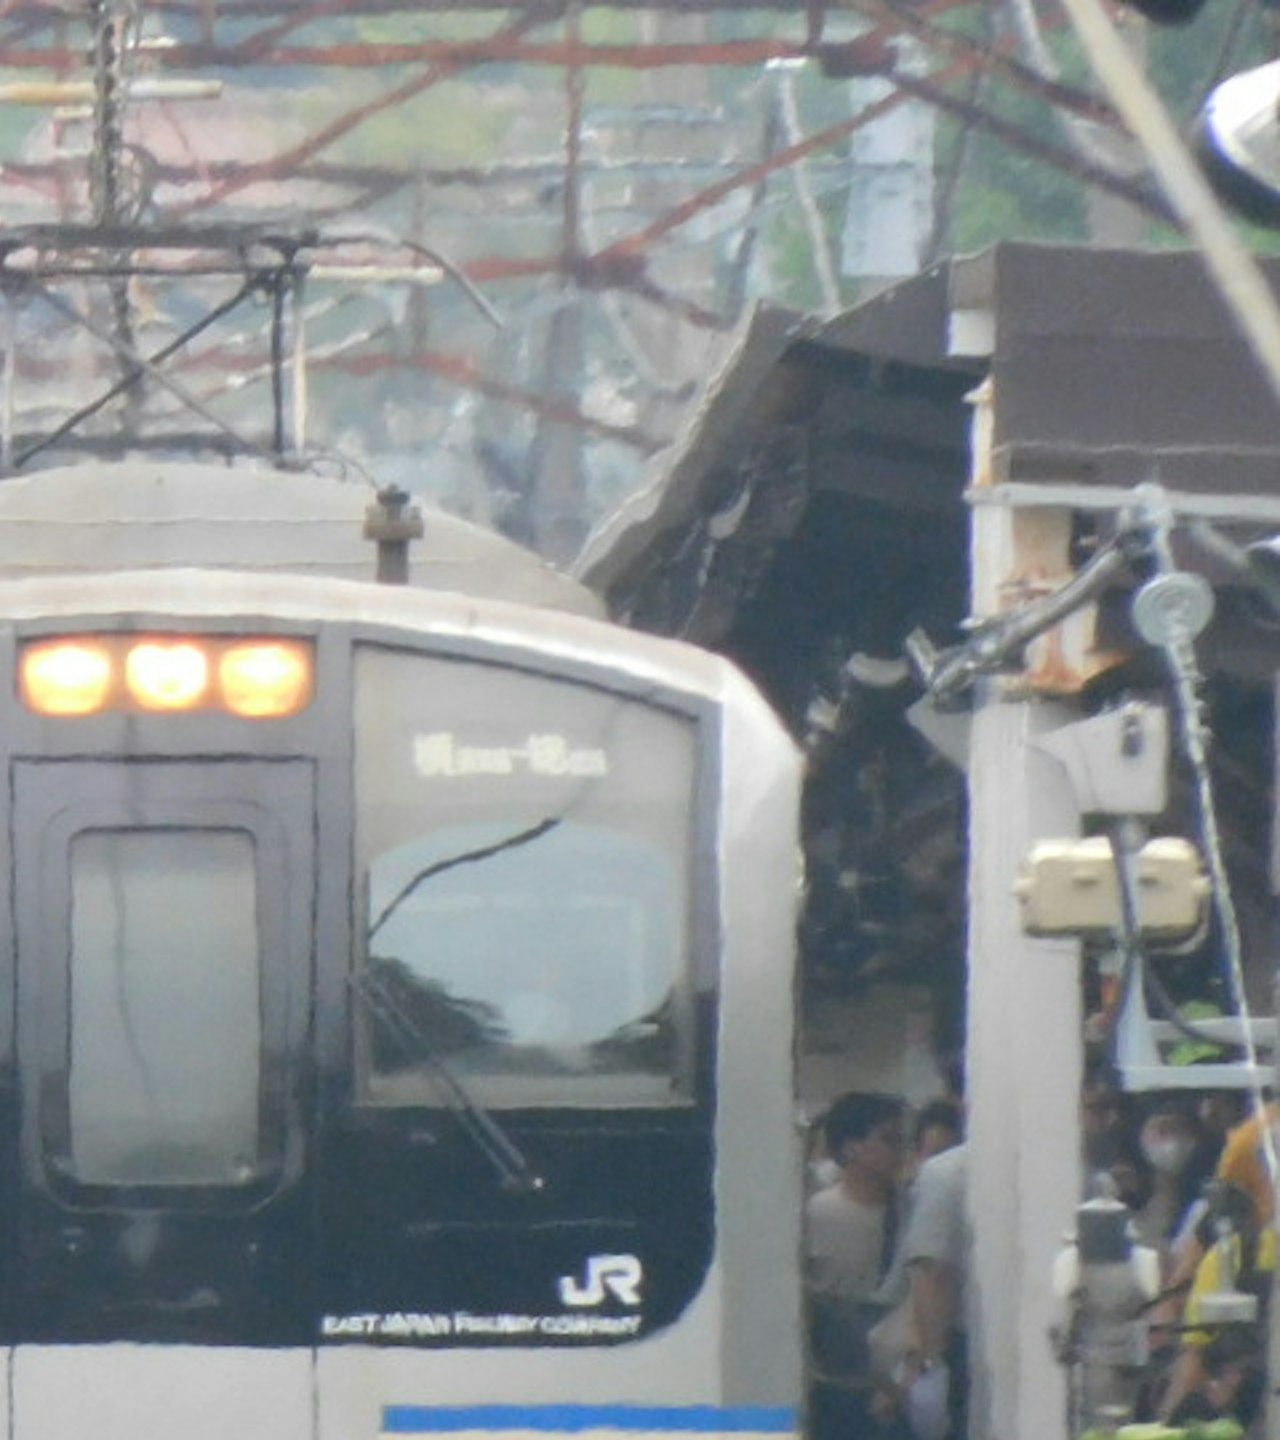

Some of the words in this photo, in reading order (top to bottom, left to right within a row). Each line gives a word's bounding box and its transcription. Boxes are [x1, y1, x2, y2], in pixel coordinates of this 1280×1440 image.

[559, 1254, 643, 1306] JR
[321, 1314, 379, 1335] EAST
[380, 1311, 451, 1336] JAPAN
